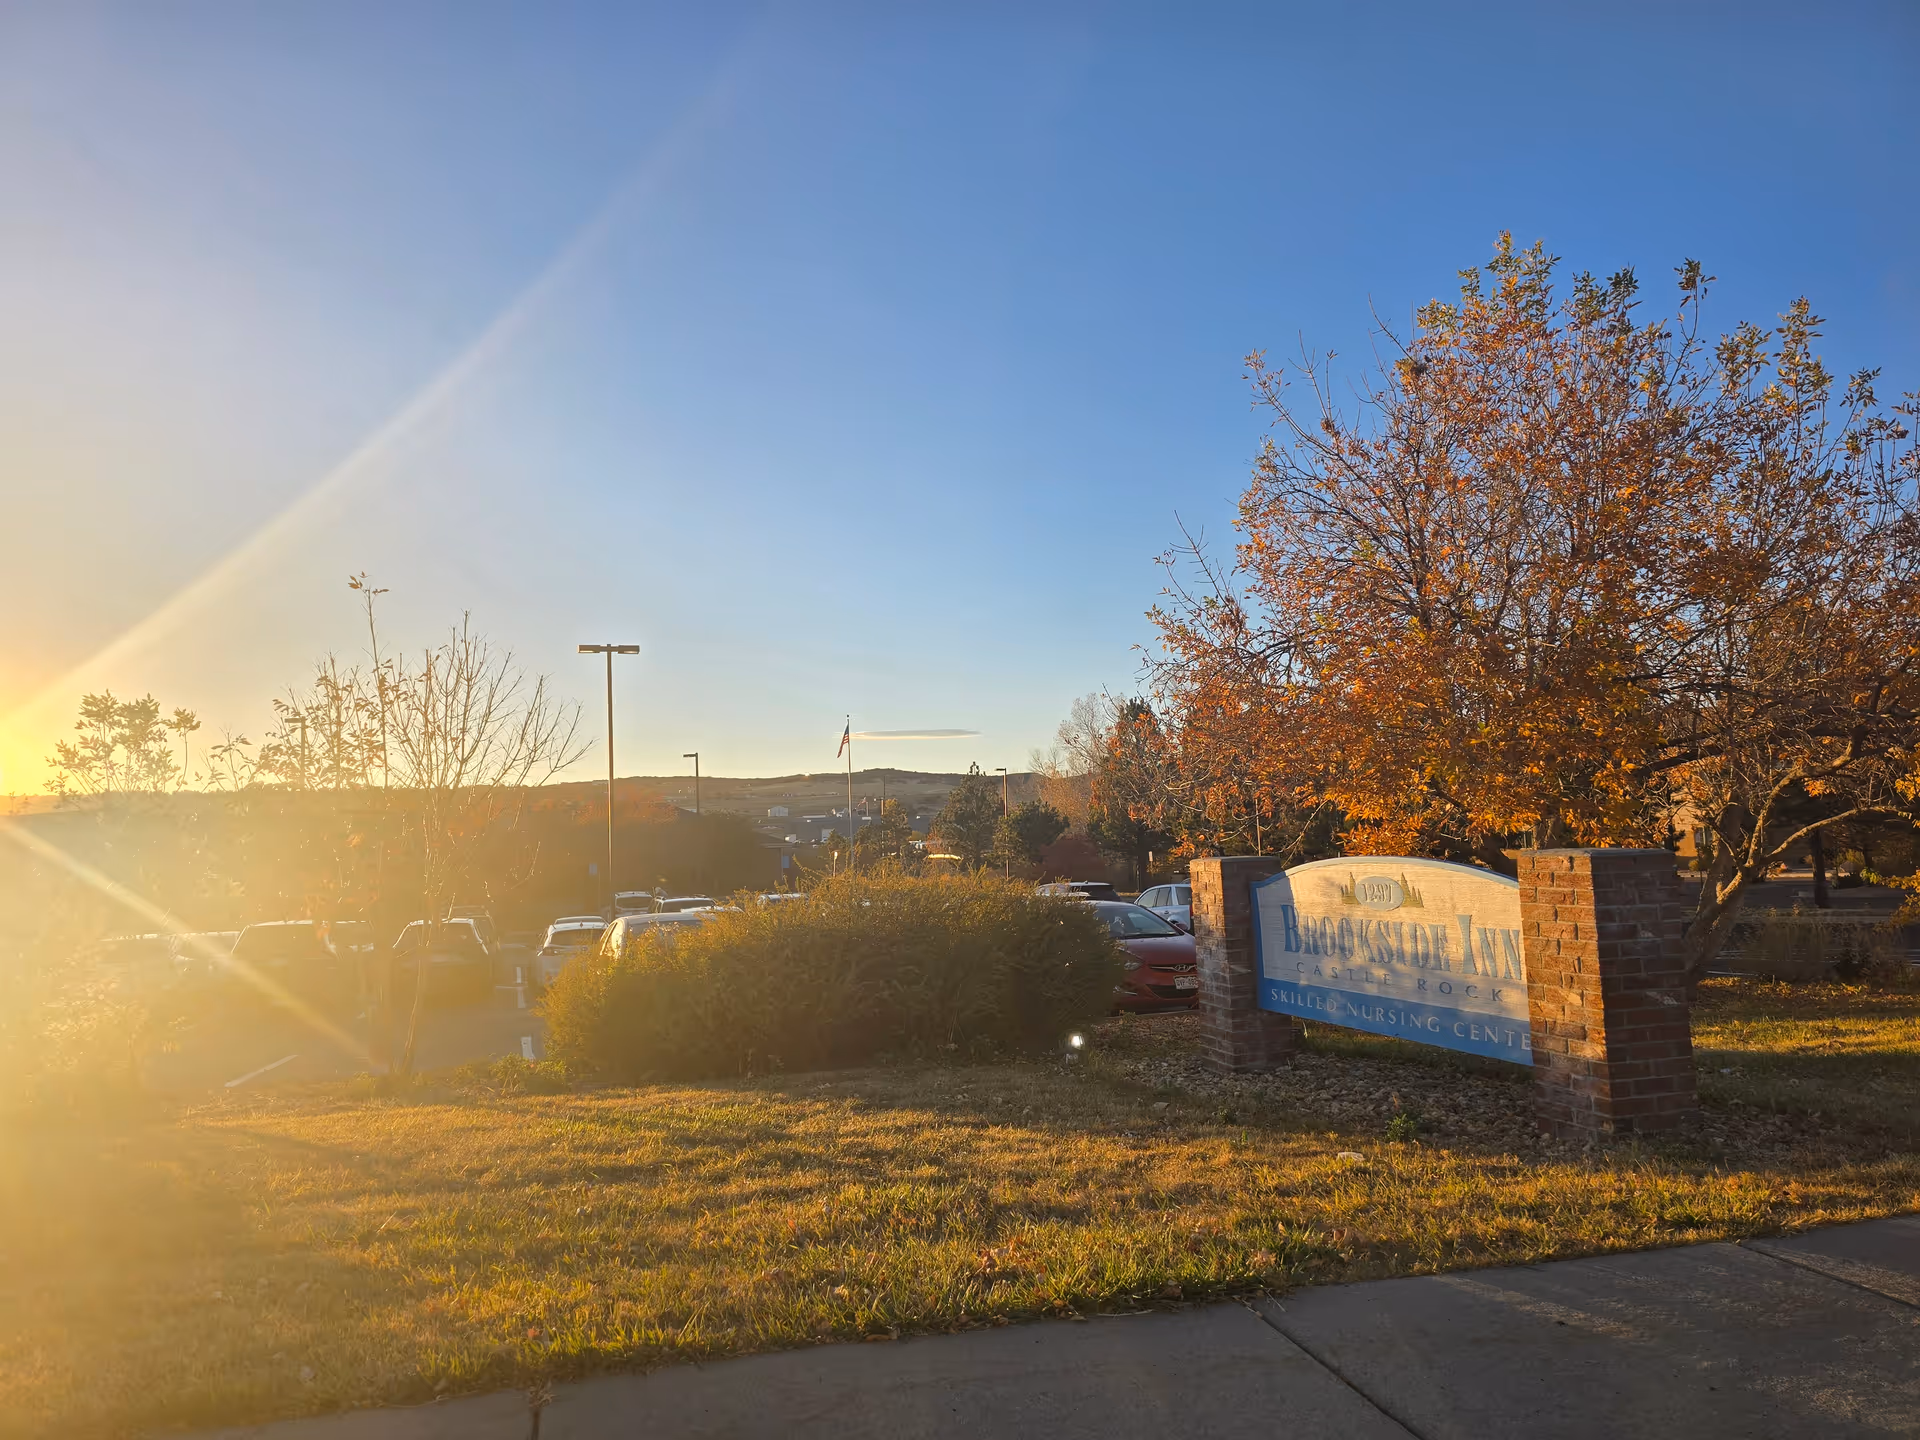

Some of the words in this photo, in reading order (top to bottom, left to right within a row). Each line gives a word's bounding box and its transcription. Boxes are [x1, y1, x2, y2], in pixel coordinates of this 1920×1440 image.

[1280, 904, 1451, 972] BROOKSIDE
[1455, 914, 1522, 980] INN
[1296, 961, 1391, 986] CASTLE
[1417, 978, 1503, 1002] ROCK
[1271, 988, 1338, 1012] SKILLED
[1347, 1002, 1441, 1033] NURSING
[1453, 1021, 1532, 1051] CENTE
